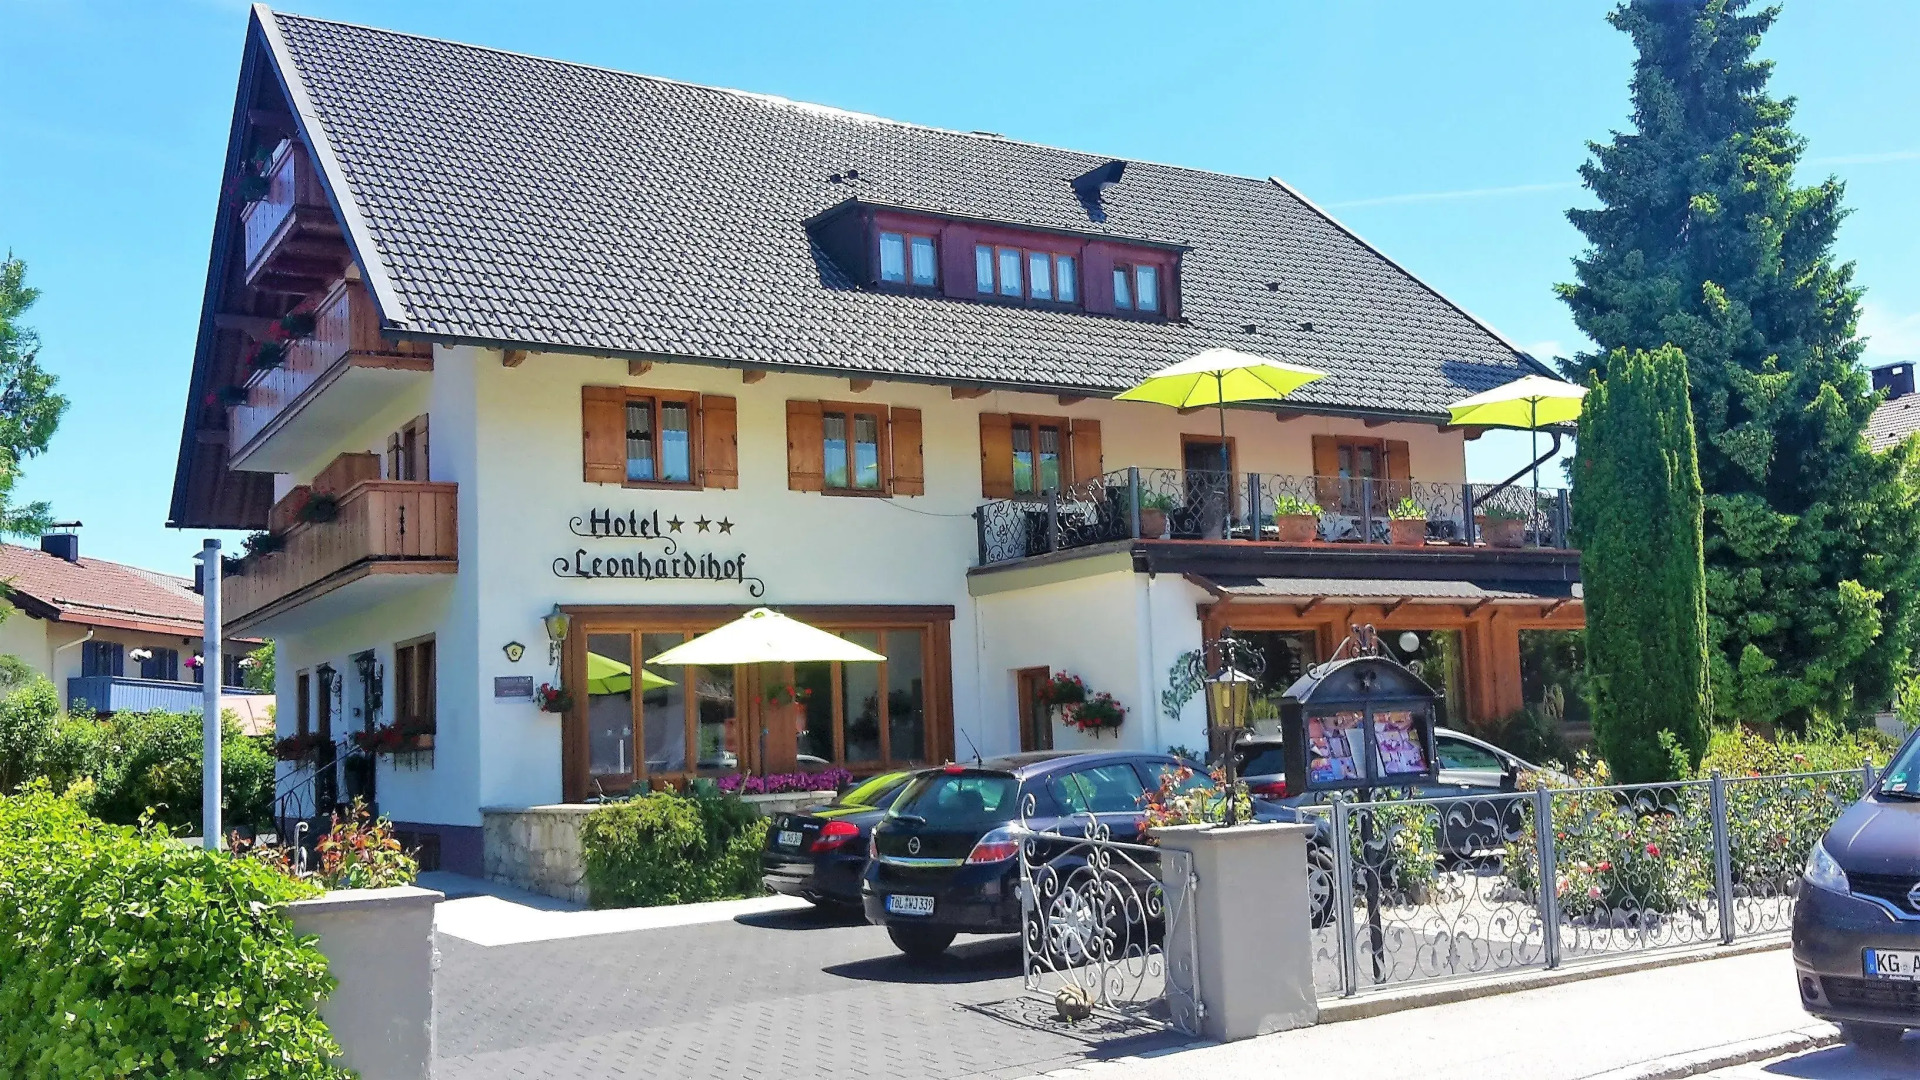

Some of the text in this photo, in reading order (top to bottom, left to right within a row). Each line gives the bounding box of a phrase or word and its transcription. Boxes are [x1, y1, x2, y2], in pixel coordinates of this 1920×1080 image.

[589, 507, 661, 537] Hotel
[575, 548, 747, 583] Leonhardihof
[1877, 953, 1900, 973] KG
